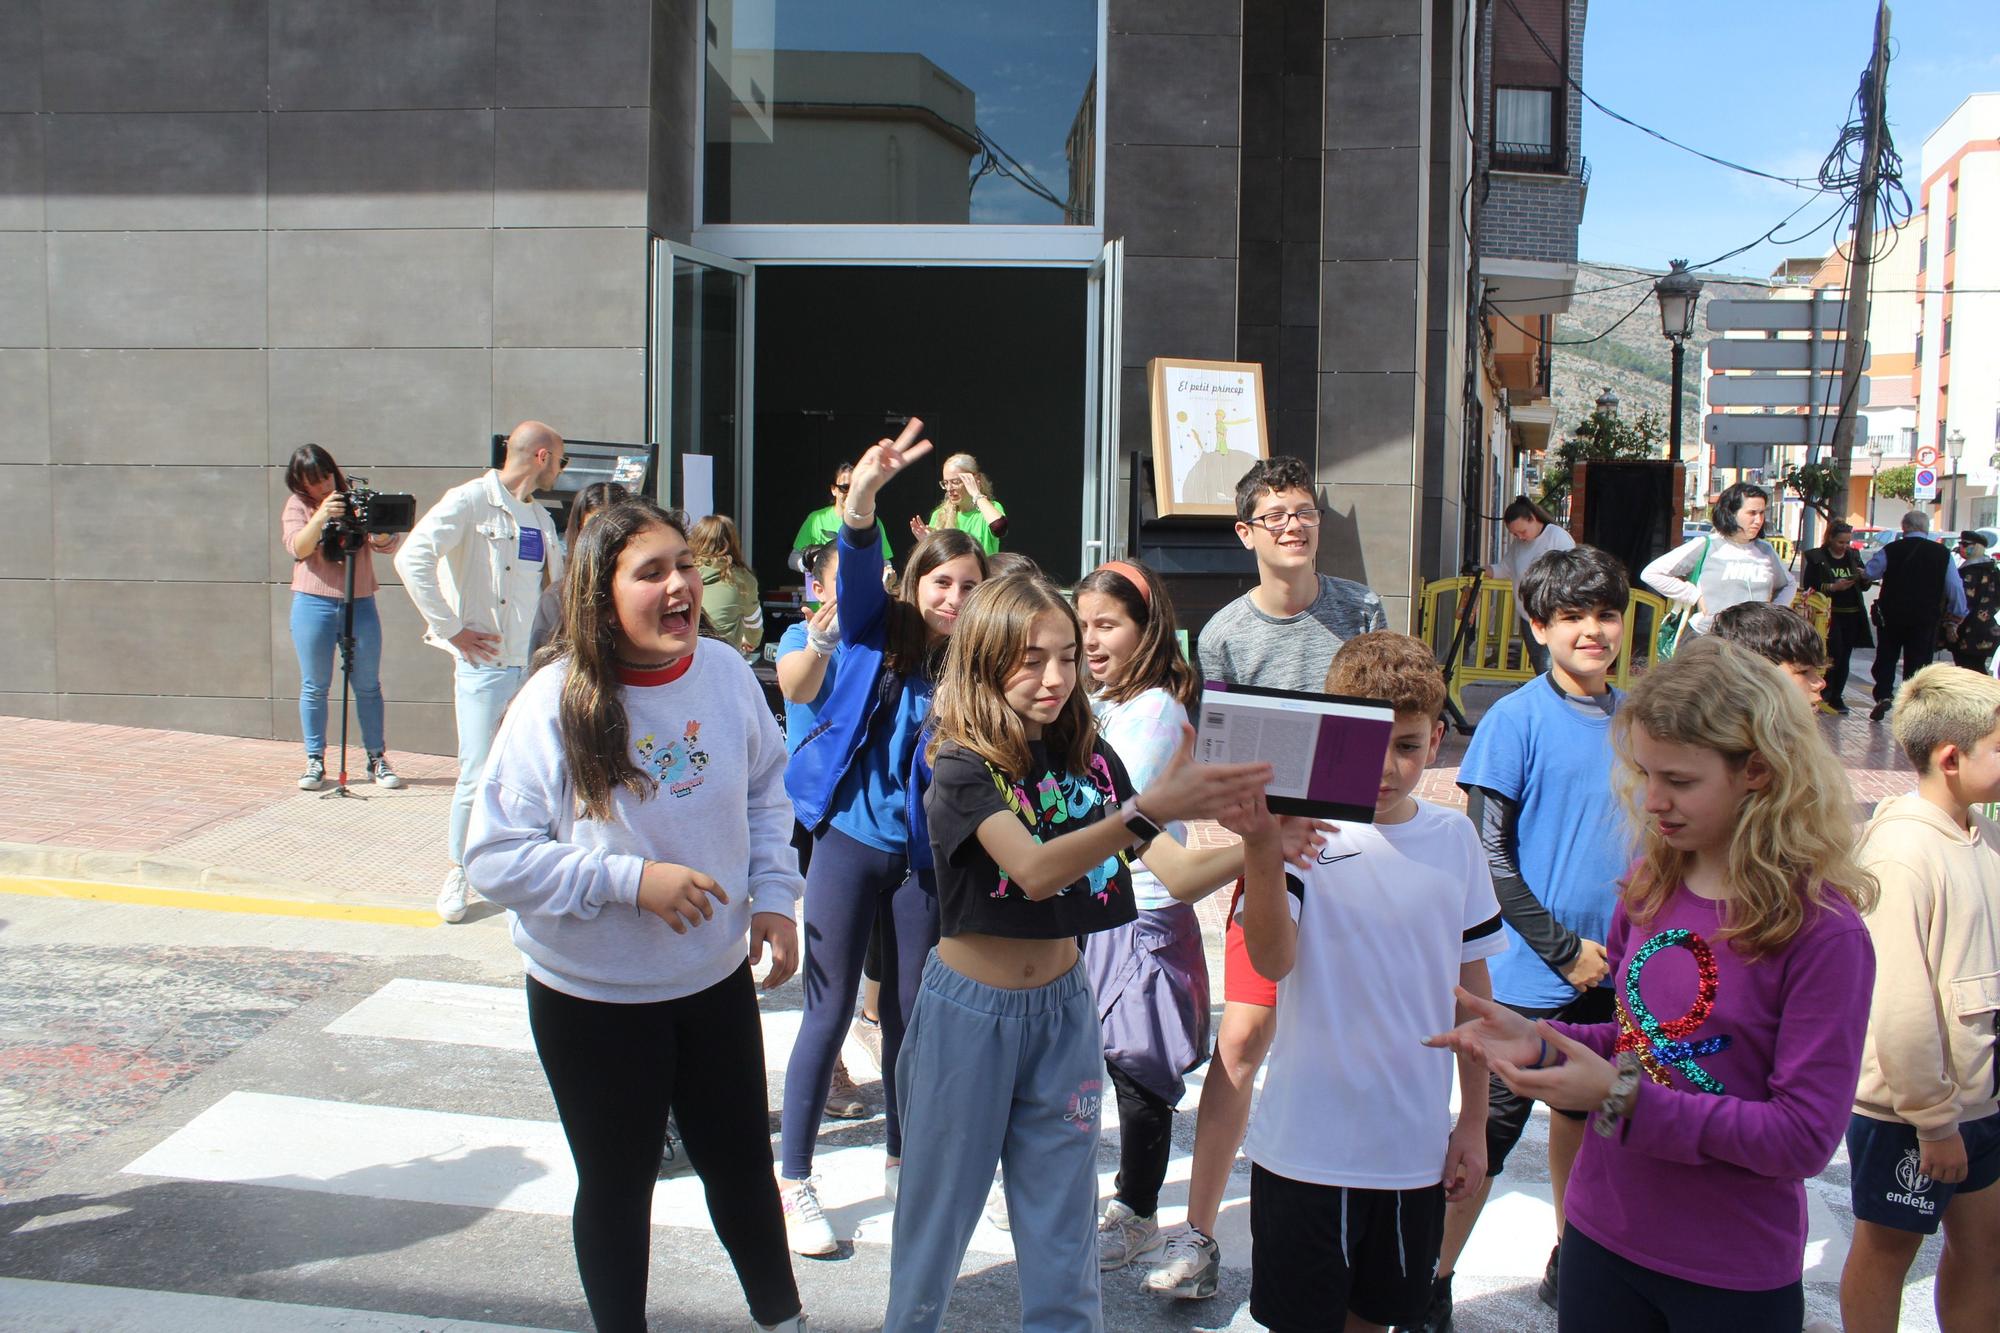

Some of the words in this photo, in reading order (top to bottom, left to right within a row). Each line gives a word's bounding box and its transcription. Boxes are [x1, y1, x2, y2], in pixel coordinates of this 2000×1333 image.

[1178, 380, 1188, 392] El
[1189, 382, 1209, 393] petit
[1721, 561, 1773, 582] NIKE
[1886, 1191, 1935, 1210] endeka
